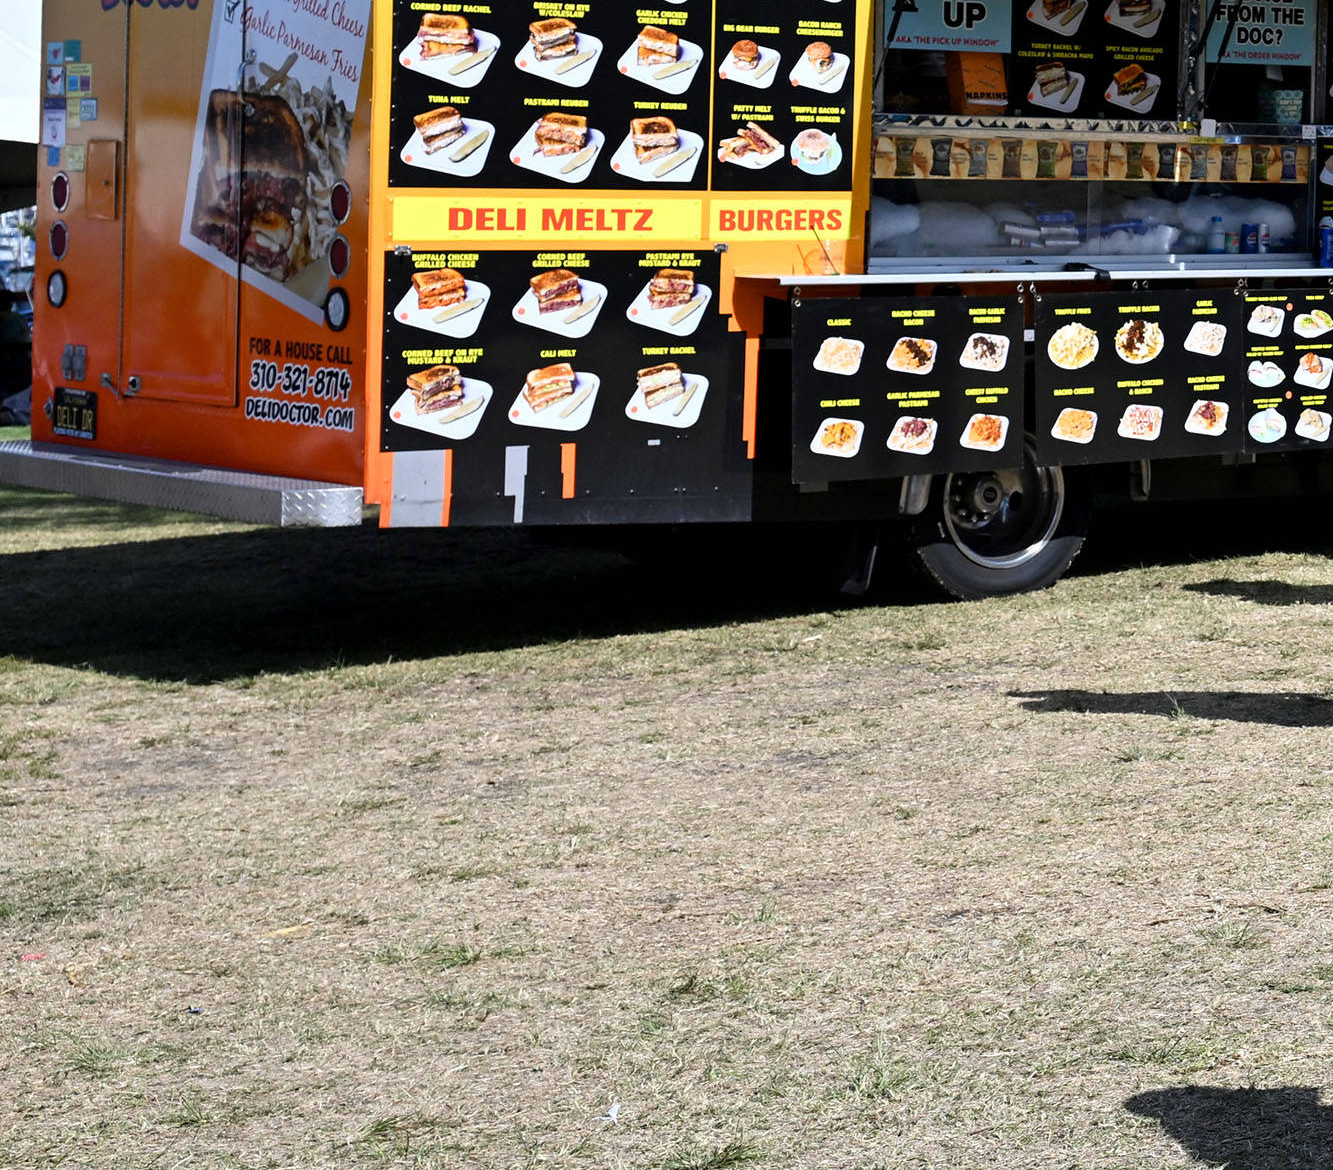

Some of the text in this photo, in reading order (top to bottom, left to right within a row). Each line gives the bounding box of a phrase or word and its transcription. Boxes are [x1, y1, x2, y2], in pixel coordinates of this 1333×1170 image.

[410, 2, 491, 14] CORNED BEEF RACHEL
[942, 1, 987, 29] UP
[1215, 4, 1305, 26] FROM THE
[330, 2, 365, 39] Cheese
[240, 4, 359, 82] Garlic Parmesan Fries
[895, 36, 912, 44] AKA
[932, 36, 950, 45] PICK
[950, 37, 961, 46] UP
[962, 38, 1000, 47] WINDOW"
[1236, 26, 1284, 46] DOC?
[1247, 52, 1270, 60] ORDER
[428, 95, 470, 104] TUNA MELT
[966, 91, 1008, 100] NAPKINS
[448, 207, 653, 231] DELI MELTZ
[718, 209, 842, 231] BURGERS
[411, 254, 445, 262] BUFFALO
[250, 337, 352, 365] FOR A HOUSE CALL
[250, 360, 351, 402] 310-321-8714
[57, 405, 94, 432] DELI DR
[245, 397, 355, 432] DELIDOCTOR.COM
